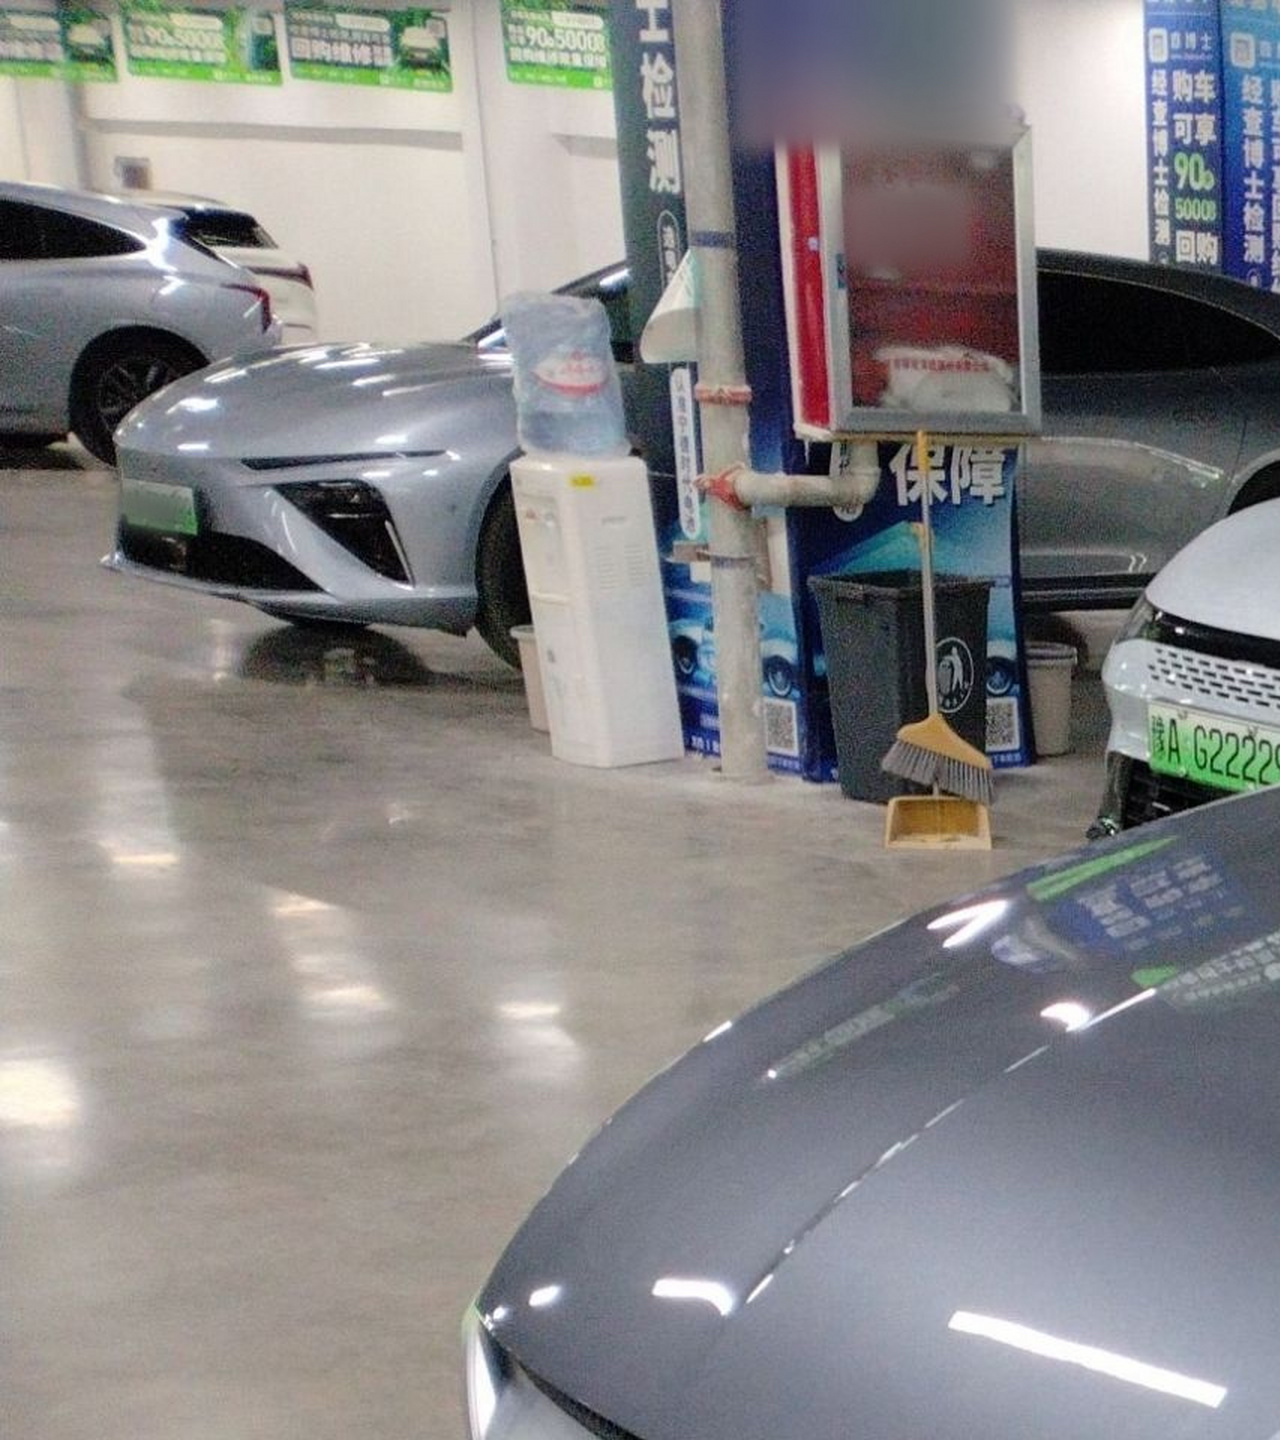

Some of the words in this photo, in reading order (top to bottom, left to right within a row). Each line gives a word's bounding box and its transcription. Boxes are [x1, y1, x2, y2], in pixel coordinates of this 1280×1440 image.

[1172, 69, 1217, 104] 购车
[1173, 114, 1217, 147] 可享
[1175, 229, 1218, 266] 回购
[889, 443, 1006, 506] 保障
